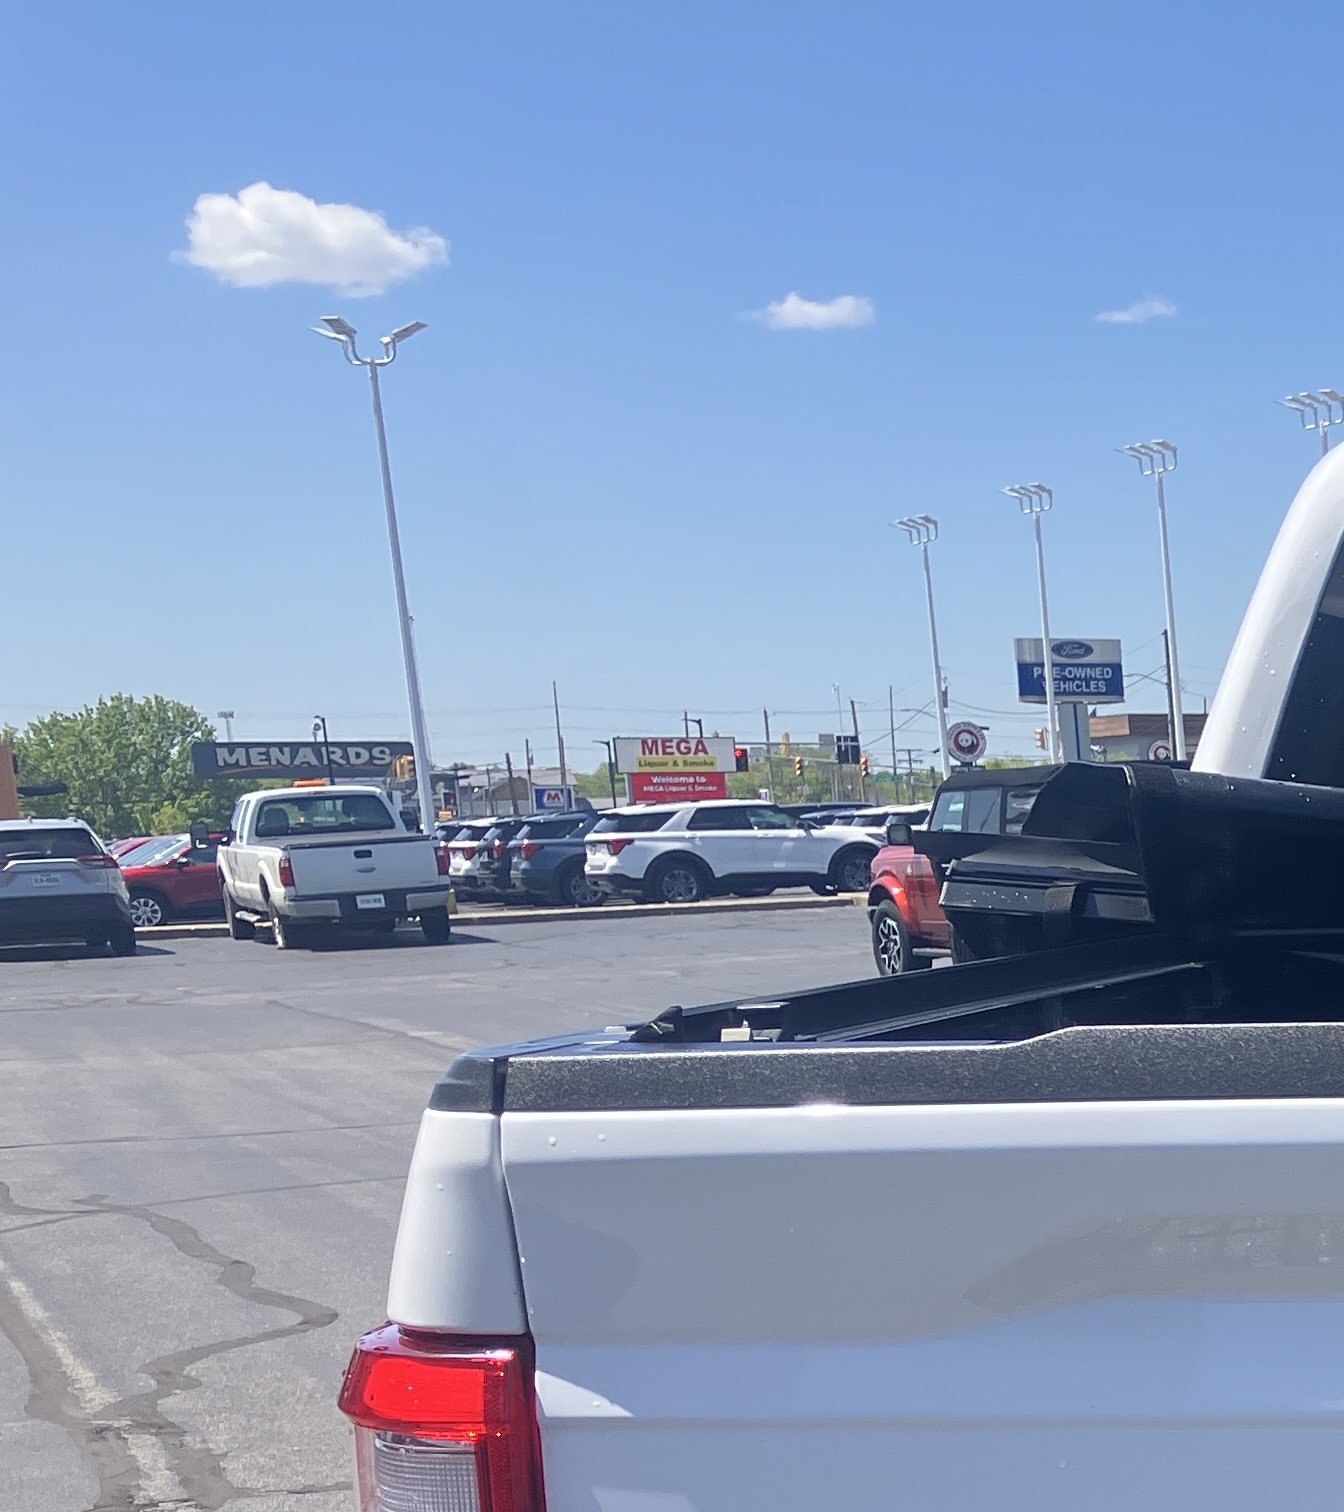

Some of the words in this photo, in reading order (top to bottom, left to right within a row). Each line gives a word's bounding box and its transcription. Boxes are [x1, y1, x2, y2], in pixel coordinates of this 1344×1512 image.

[1033, 666, 1113, 679] PE-OWNED
[641, 737, 709, 756] MEGA
[215, 746, 393, 766] MENARDS
[638, 759, 669, 768] Liquor
[672, 759, 680, 767] &
[682, 759, 715, 767] Smoke
[650, 776, 695, 784] Welcome
